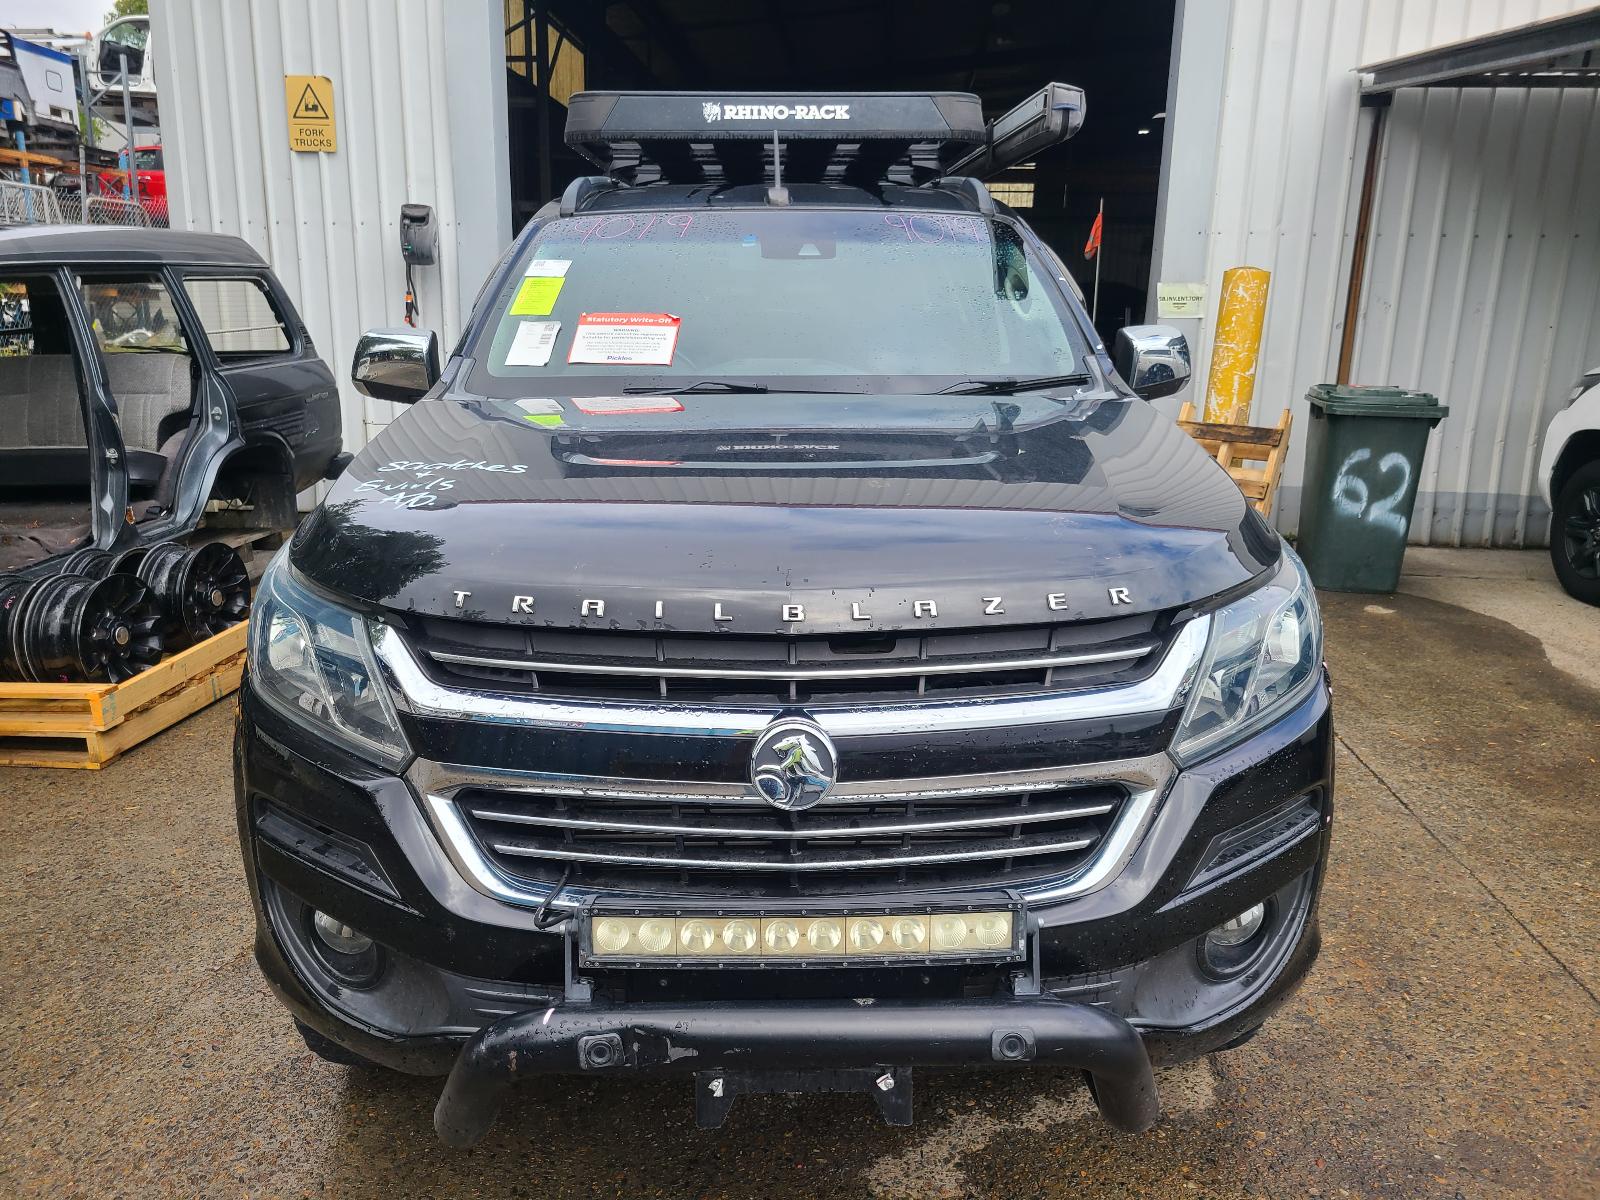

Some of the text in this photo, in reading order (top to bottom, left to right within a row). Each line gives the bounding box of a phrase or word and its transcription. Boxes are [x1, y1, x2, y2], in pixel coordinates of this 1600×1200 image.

[724, 105, 850, 120] RHINO-RACK
[299, 128, 325, 137] FORK
[294, 138, 332, 147] TRUCKS
[575, 214, 692, 245] 9019
[586, 316, 628, 324] Statutory
[1332, 447, 1411, 537] 62
[453, 586, 1133, 623] TRAILBLAZER
